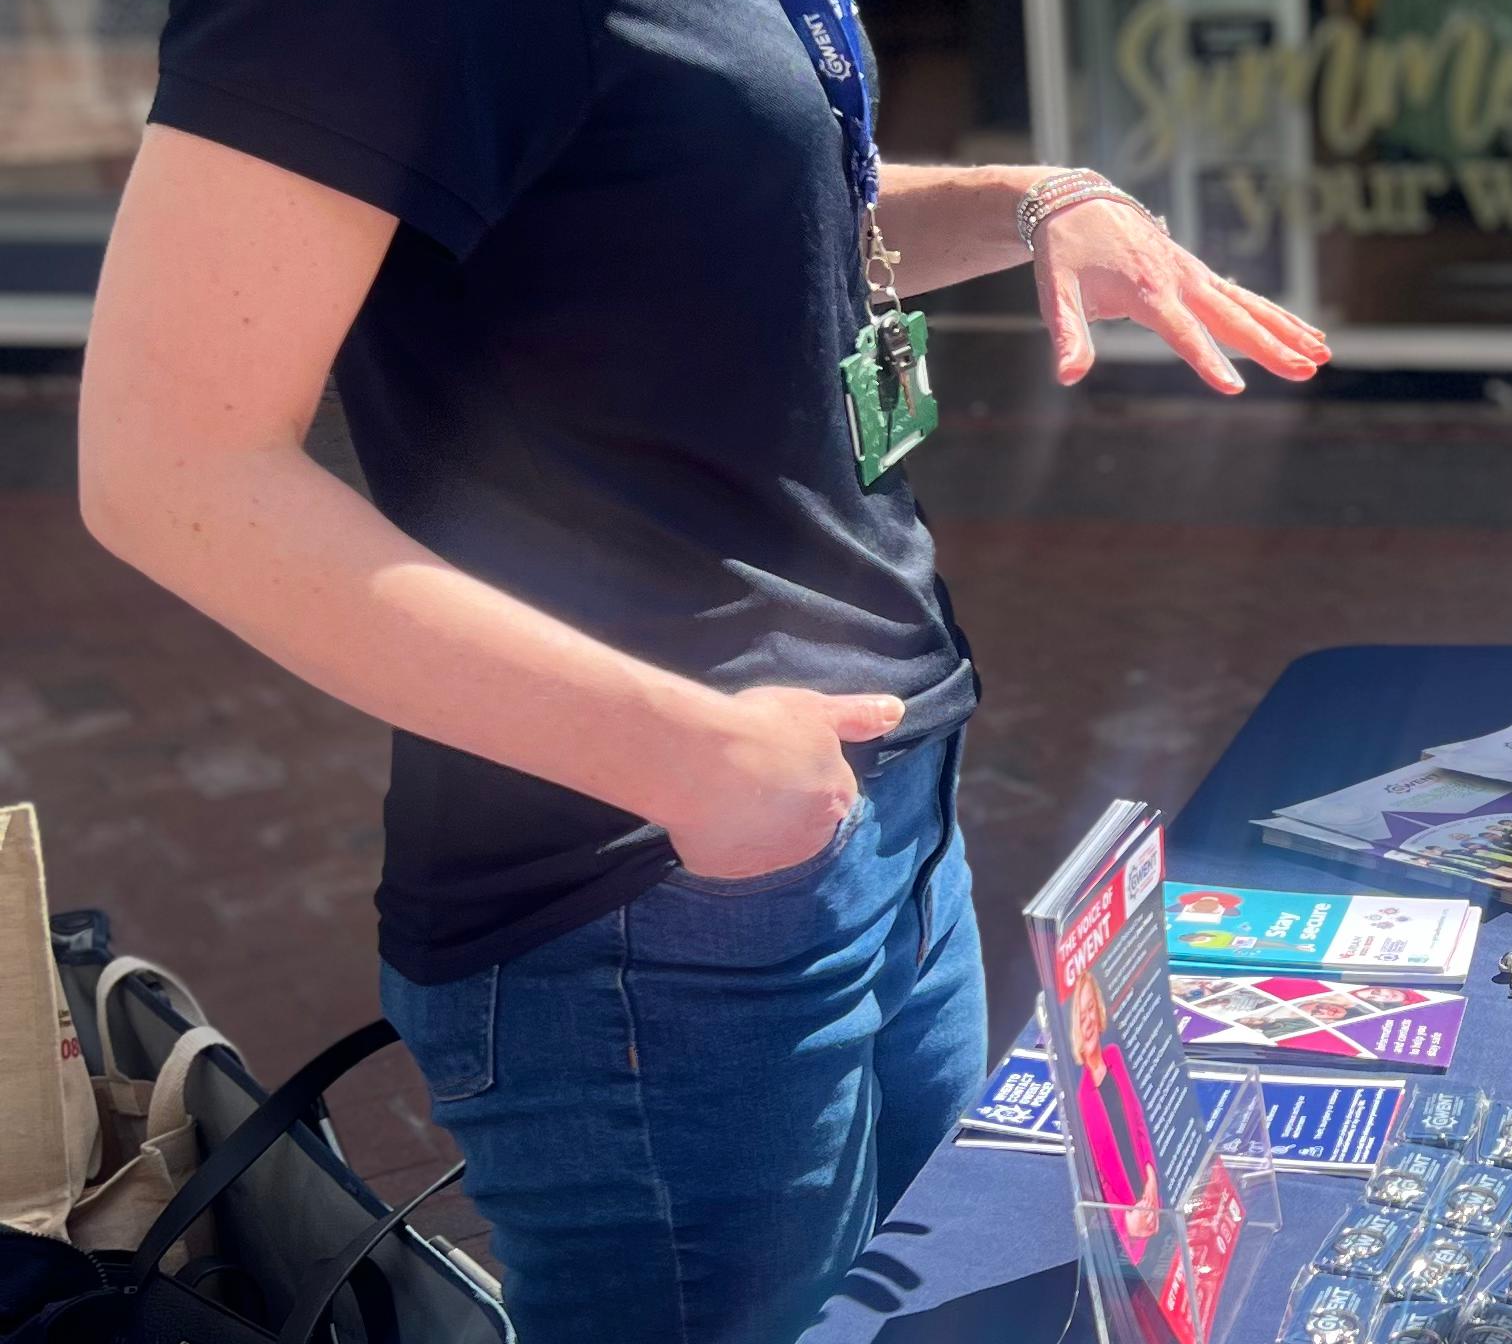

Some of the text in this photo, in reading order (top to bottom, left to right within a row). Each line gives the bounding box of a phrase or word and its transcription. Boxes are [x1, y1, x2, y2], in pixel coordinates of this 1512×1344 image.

[803, 12, 845, 75] GWENT
[1060, 886, 1114, 961] THE VOICE OF
[1265, 911, 1300, 938] Stay
[1299, 902, 1331, 940] secure
[1064, 912, 1112, 988] GWENT
[1005, 1073, 1021, 1083] TO
[1005, 1072, 1034, 1103] CONTACT
[1018, 1081, 1041, 1104] GWENT
[1433, 1093, 1454, 1127] GWENT
